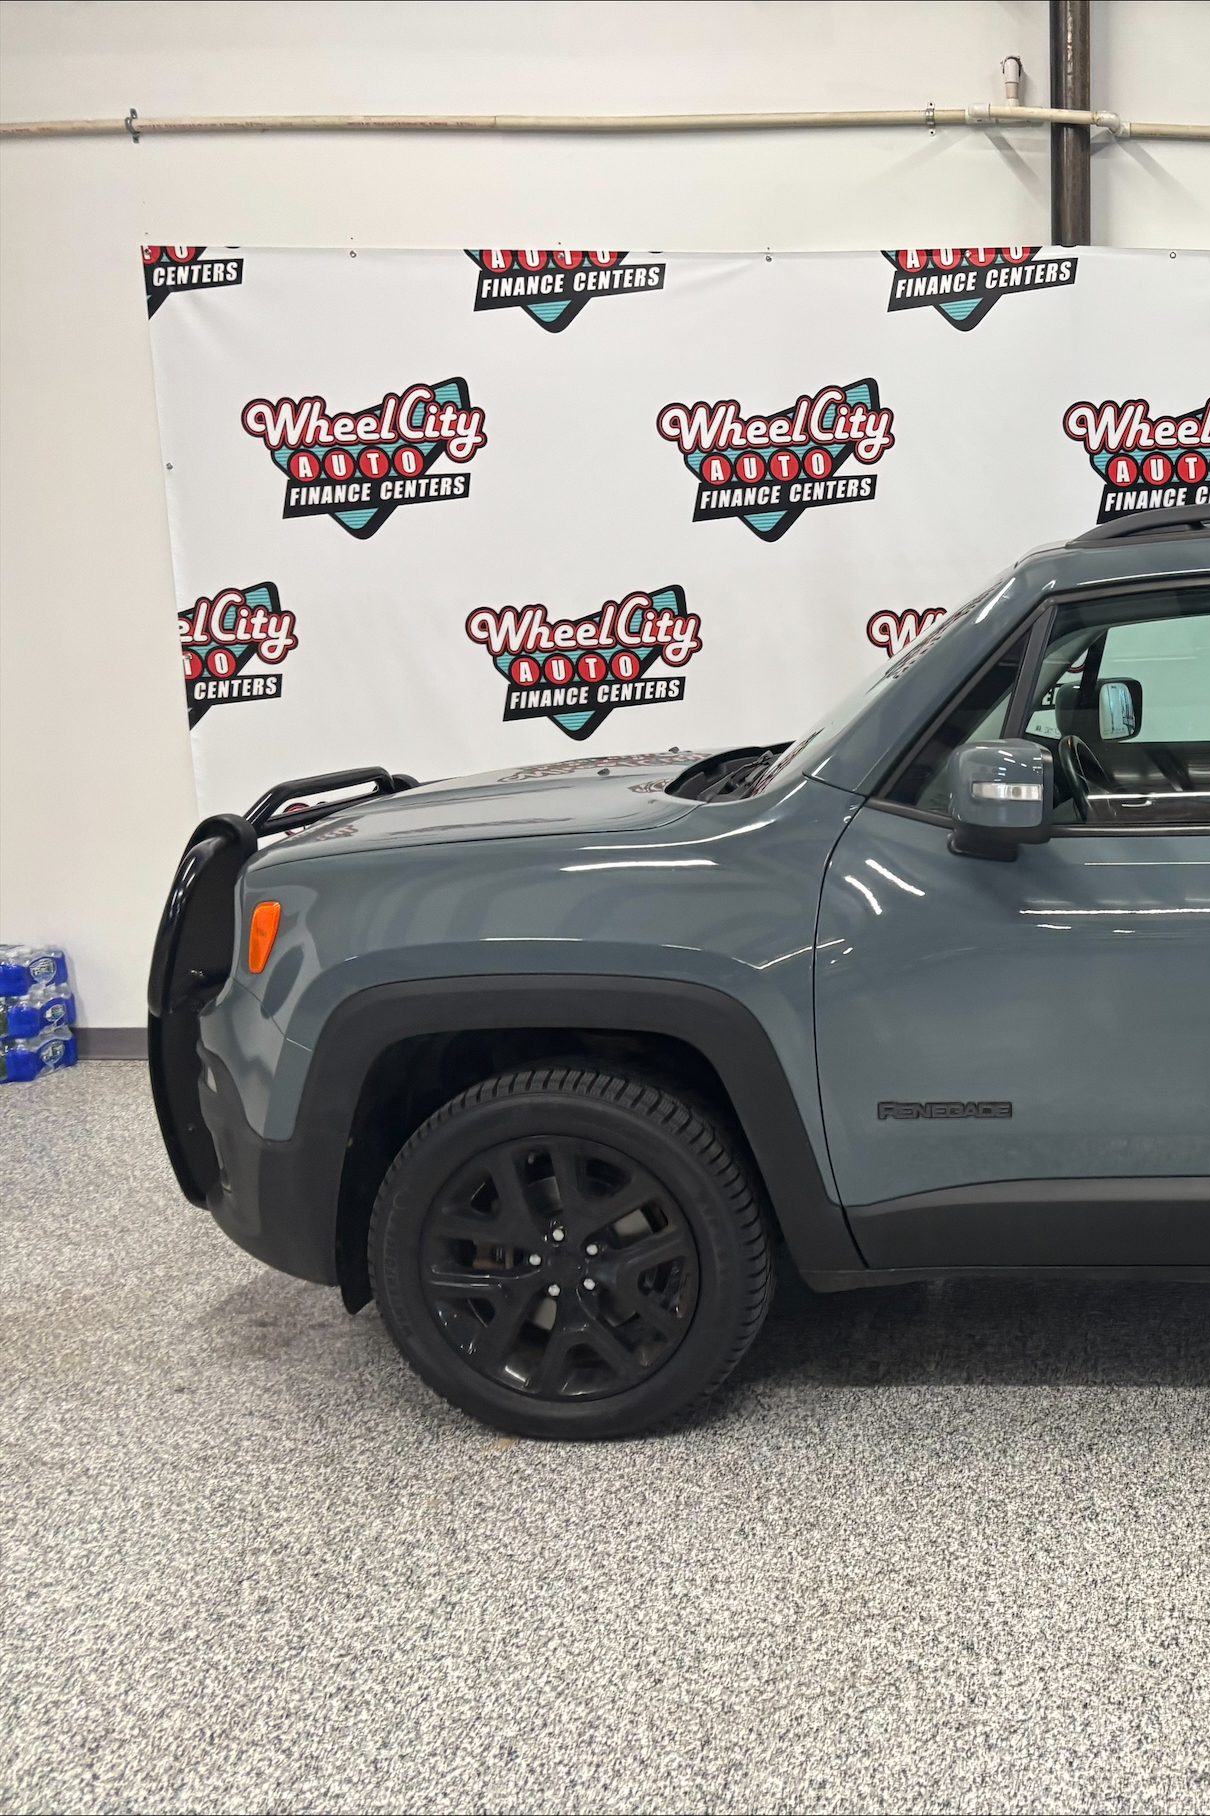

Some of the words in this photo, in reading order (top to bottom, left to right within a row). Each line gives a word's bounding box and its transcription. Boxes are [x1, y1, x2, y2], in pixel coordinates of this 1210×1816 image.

[152, 261, 239, 287] CENTERS
[481, 273, 565, 299] FINANCE
[573, 266, 661, 292] CENTERS
[895, 271, 978, 299] FINANCE
[985, 261, 1072, 290] CENTERS
[298, 451, 417, 478] AUTO
[711, 452, 825, 481] AUTO
[289, 482, 372, 506] FINANCE
[380, 476, 466, 500] CENTERS
[700, 485, 781, 509] FINANCE
[789, 478, 872, 503] CENTERS
[1104, 487, 1187, 512] FINANCE
[211, 593, 294, 660] City
[182, 652, 229, 675] TO
[519, 655, 634, 683] AUTO
[193, 676, 278, 701] CENTERS
[509, 686, 589, 710] FINANCE
[597, 679, 680, 703] CENTERS
[877, 1102, 1013, 1120] RENEGADE
